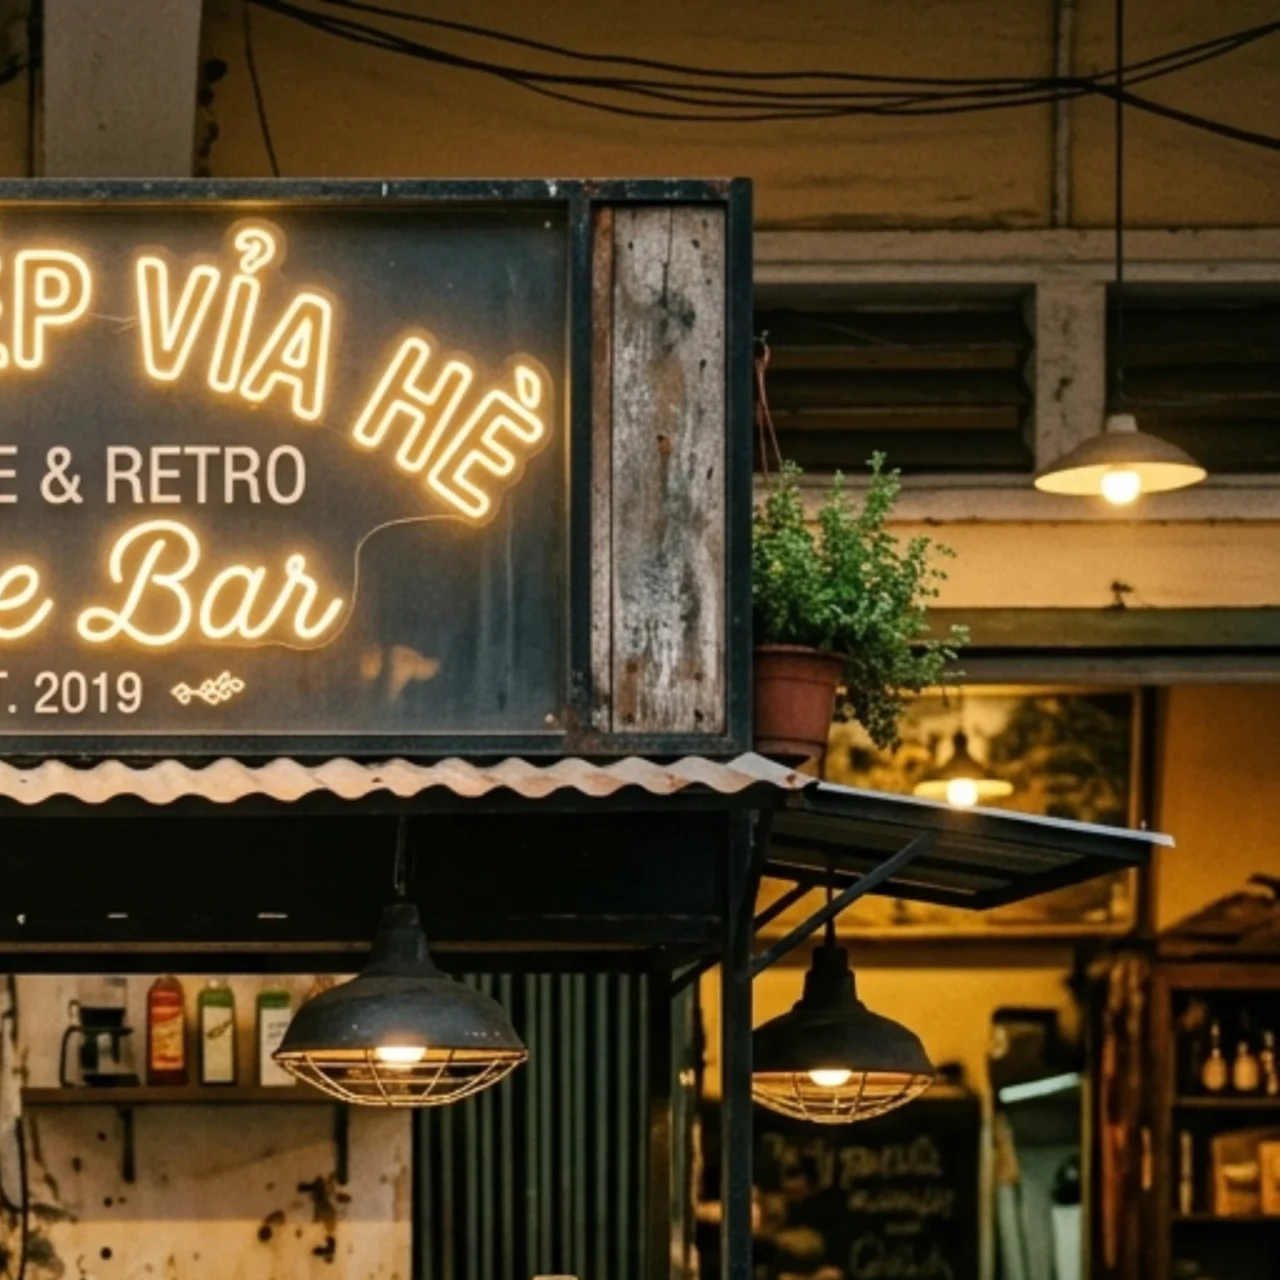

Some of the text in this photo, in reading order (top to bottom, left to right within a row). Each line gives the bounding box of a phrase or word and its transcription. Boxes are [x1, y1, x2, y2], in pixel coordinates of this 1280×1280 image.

[136, 228, 333, 422] VỈA
[40, 445, 84, 505] &
[105, 445, 306, 505] RETRO
[76, 519, 344, 646] Bar
[33, 671, 144, 714] 2019
